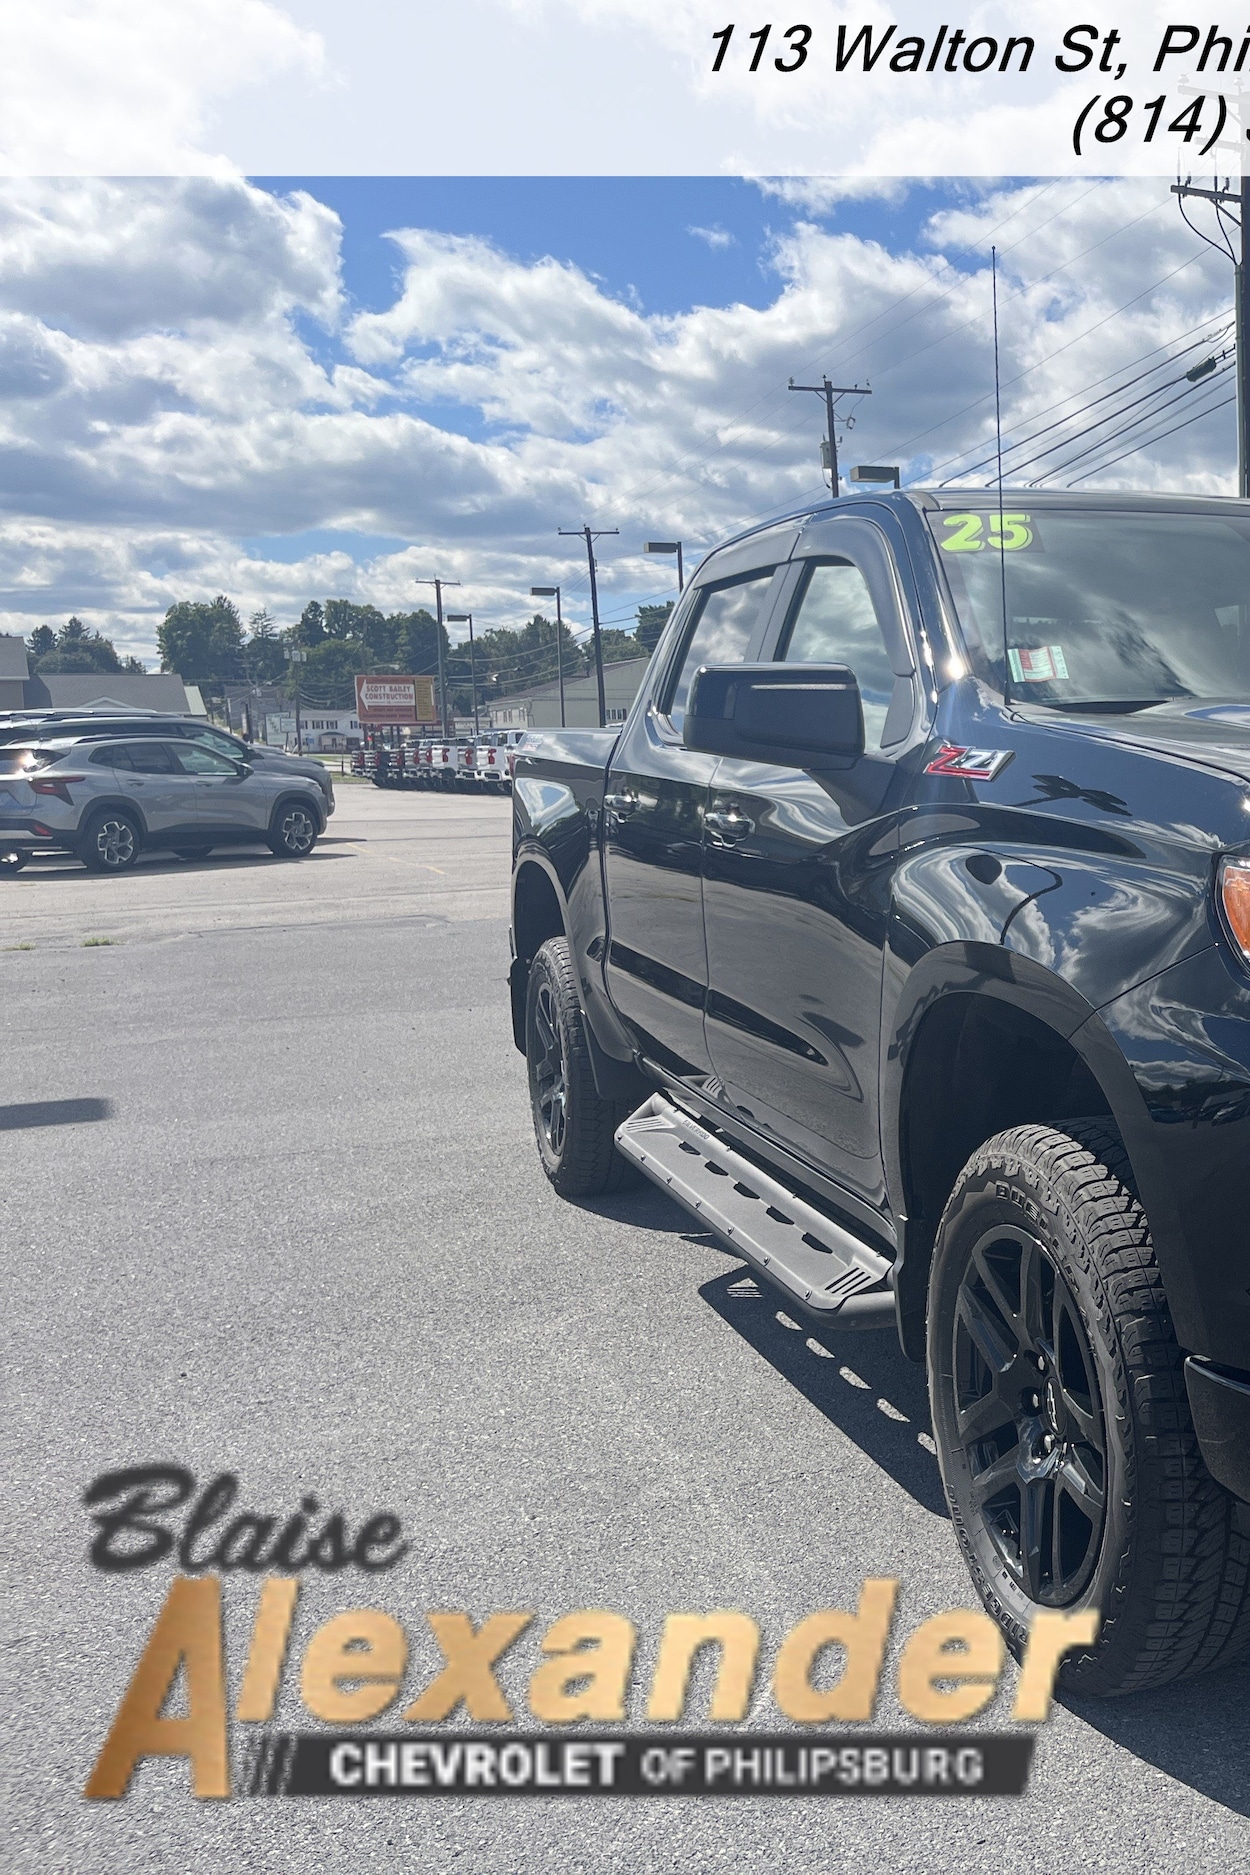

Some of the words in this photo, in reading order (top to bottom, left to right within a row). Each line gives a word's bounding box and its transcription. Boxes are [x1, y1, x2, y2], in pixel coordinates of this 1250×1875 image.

[940, 513, 1033, 553] 25
[922, 744, 1015, 782] Z71
[946, 1482, 1032, 1646] RIDGESTONE
